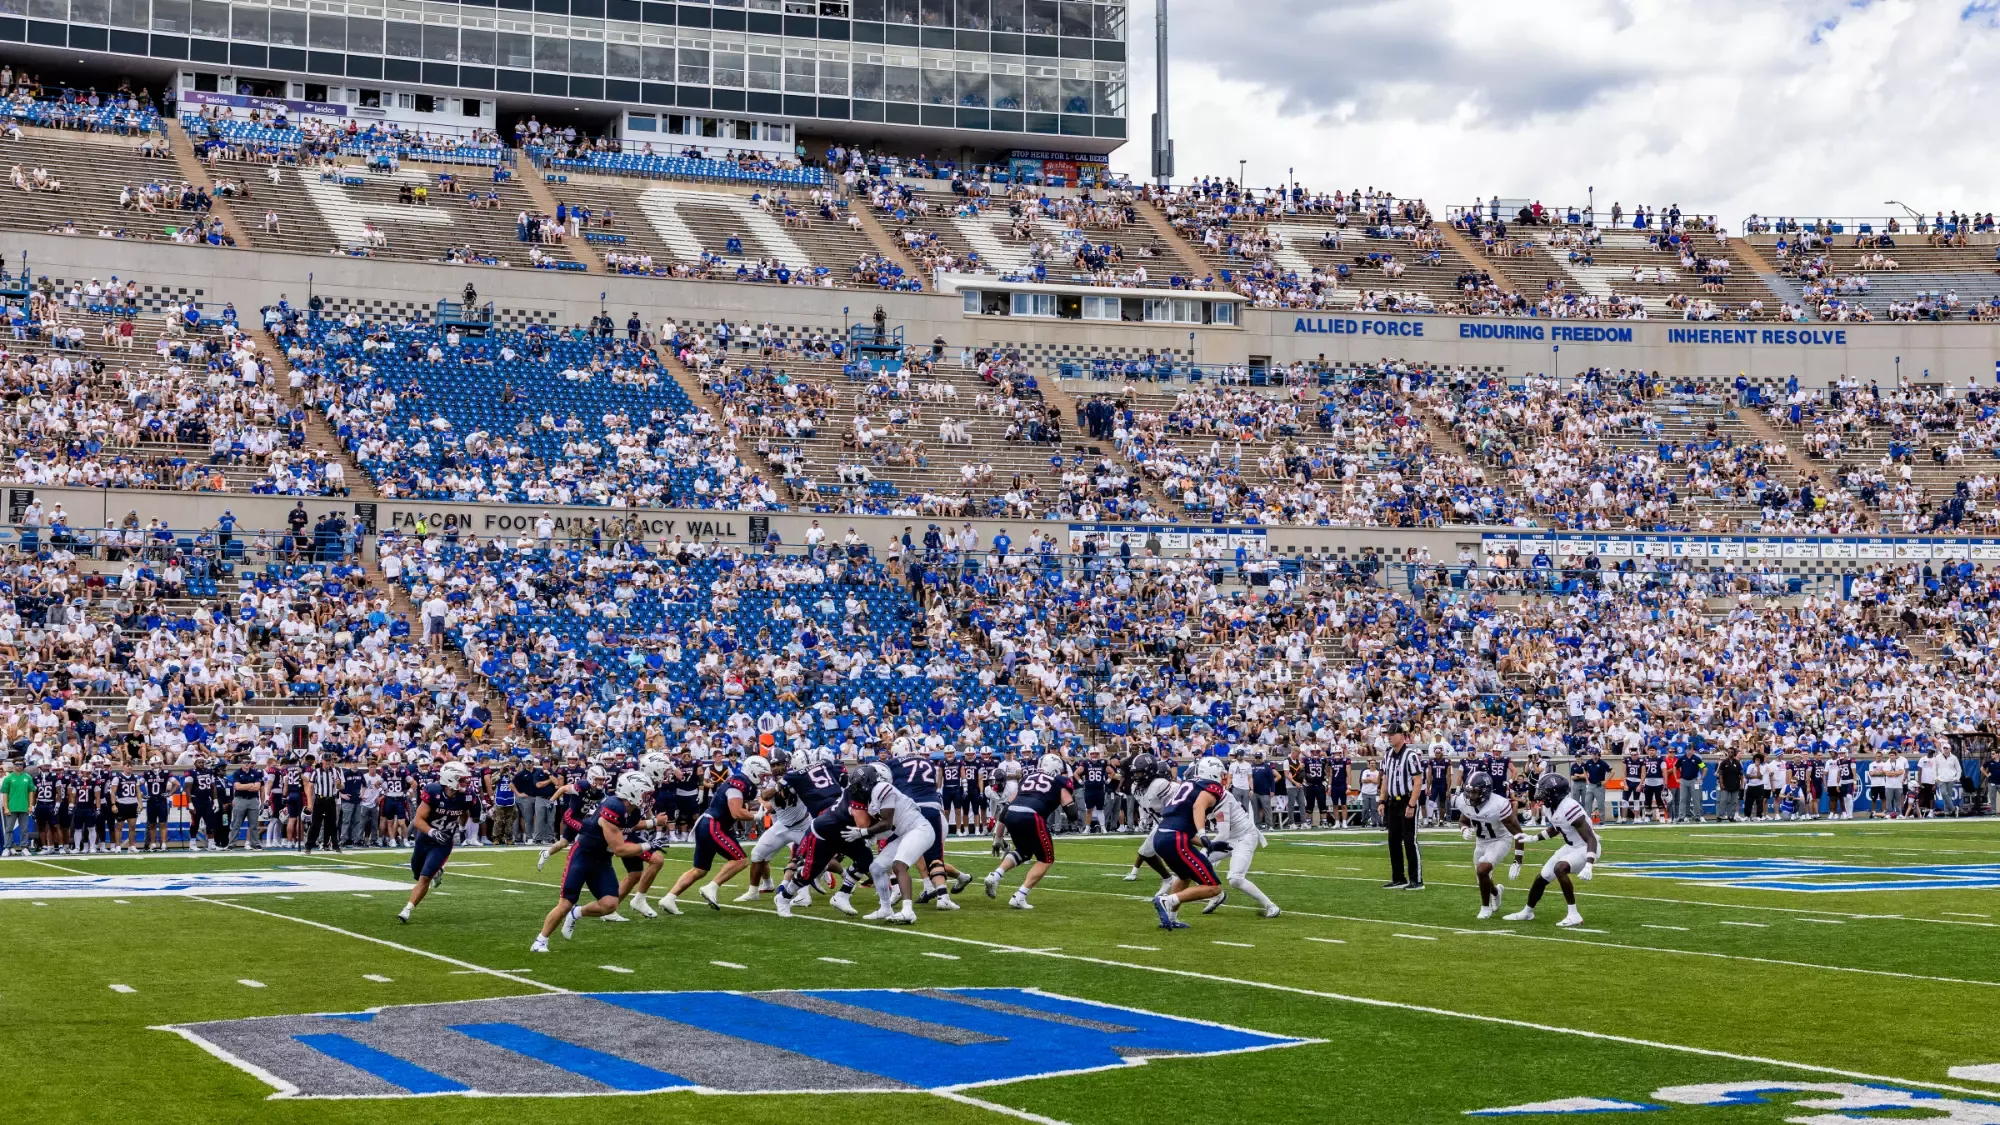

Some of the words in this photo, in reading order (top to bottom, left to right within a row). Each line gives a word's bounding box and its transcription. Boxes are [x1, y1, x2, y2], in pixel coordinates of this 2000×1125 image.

[206, 95, 228, 105] leidos
[314, 104, 336, 114] leidos
[1011, 150, 1029, 158] STOP
[1030, 151, 1050, 159] HERE
[1050, 152, 1065, 160] FOR
[1088, 154, 1108, 162] BEER
[1294, 317, 1358, 335] ALLIED
[1362, 320, 1424, 337] FORCE
[1459, 323, 1544, 341] ENDURING
[1551, 326, 1633, 343] FREEDOM
[1668, 328, 1757, 344] INHERENT
[1762, 329, 1847, 345] RESOLVE
[686, 521, 737, 536] WALL
[807, 765, 835, 789] 51
[902, 759, 936, 784] 72
[944, 769, 959, 780] 82
[965, 769, 975, 780] 81
[1088, 770, 1102, 782] 86
[1309, 766, 1323, 778] 53
[1333, 767, 1340, 778] 7
[1436, 767, 1441, 779] 11
[1490, 765, 1504, 776] 56
[1794, 770, 1806, 781] 49
[198, 777, 211, 790] 59
[287, 770, 300, 785] 92
[1020, 772, 1055, 793] 55
[37, 785, 53, 799] 26
[121, 783, 136, 797] 30
[151, 782, 160, 795] 0
[387, 780, 402, 793] 38
[78, 789, 89, 803] 21
[435, 807, 446, 815] AIR
[431, 815, 458, 833] 44
[1471, 819, 1497, 839] 21
